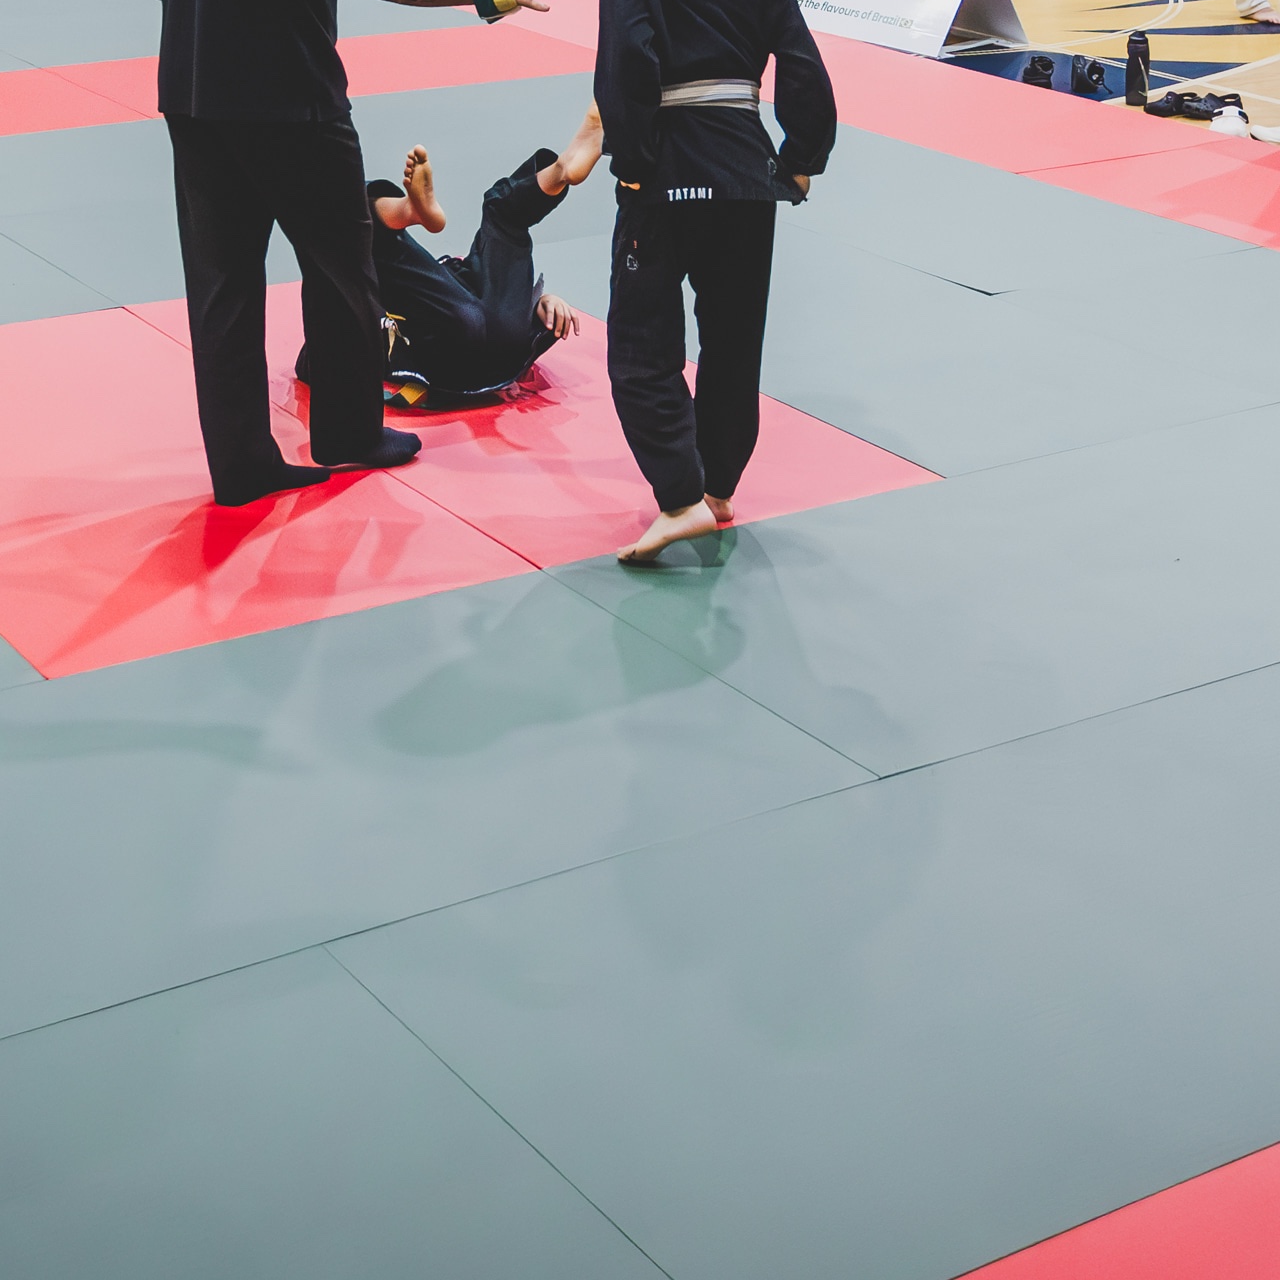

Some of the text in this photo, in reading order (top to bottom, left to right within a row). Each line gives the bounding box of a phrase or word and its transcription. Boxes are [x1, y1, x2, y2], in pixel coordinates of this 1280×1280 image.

[804, 0, 821, 10] the
[821, 1, 860, 18] flavours
[861, 10, 872, 20] of
[871, 13, 900, 26] Brazil
[667, 187, 712, 201] TATAMI
